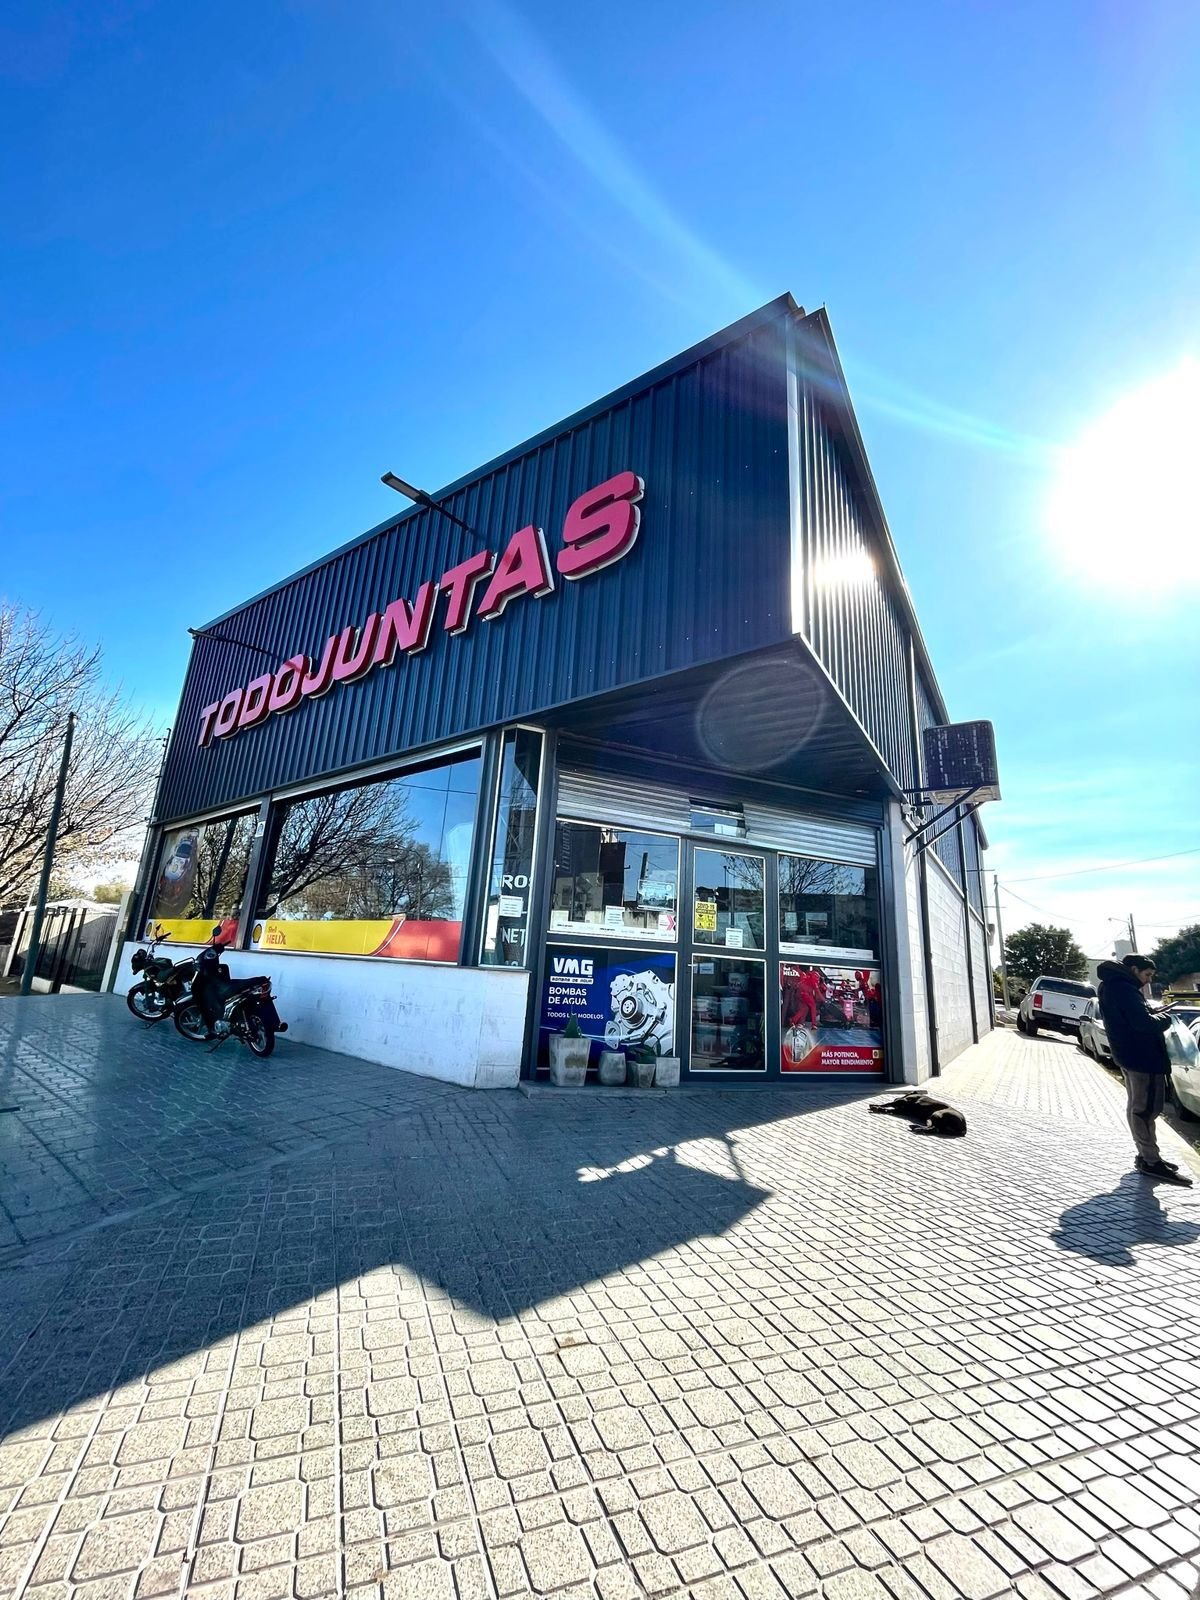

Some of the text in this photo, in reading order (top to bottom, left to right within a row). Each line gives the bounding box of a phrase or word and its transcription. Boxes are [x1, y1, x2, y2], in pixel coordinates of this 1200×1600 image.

[198, 471, 645, 748] TODOJUNTAS
[266, 932, 286, 945] HELIX
[553, 957, 594, 975] VMG
[549, 986, 588, 996] BOMBAS
[548, 996, 588, 1006] DE AGUA
[821, 1050, 860, 1059] MÁS POTENCIA,
